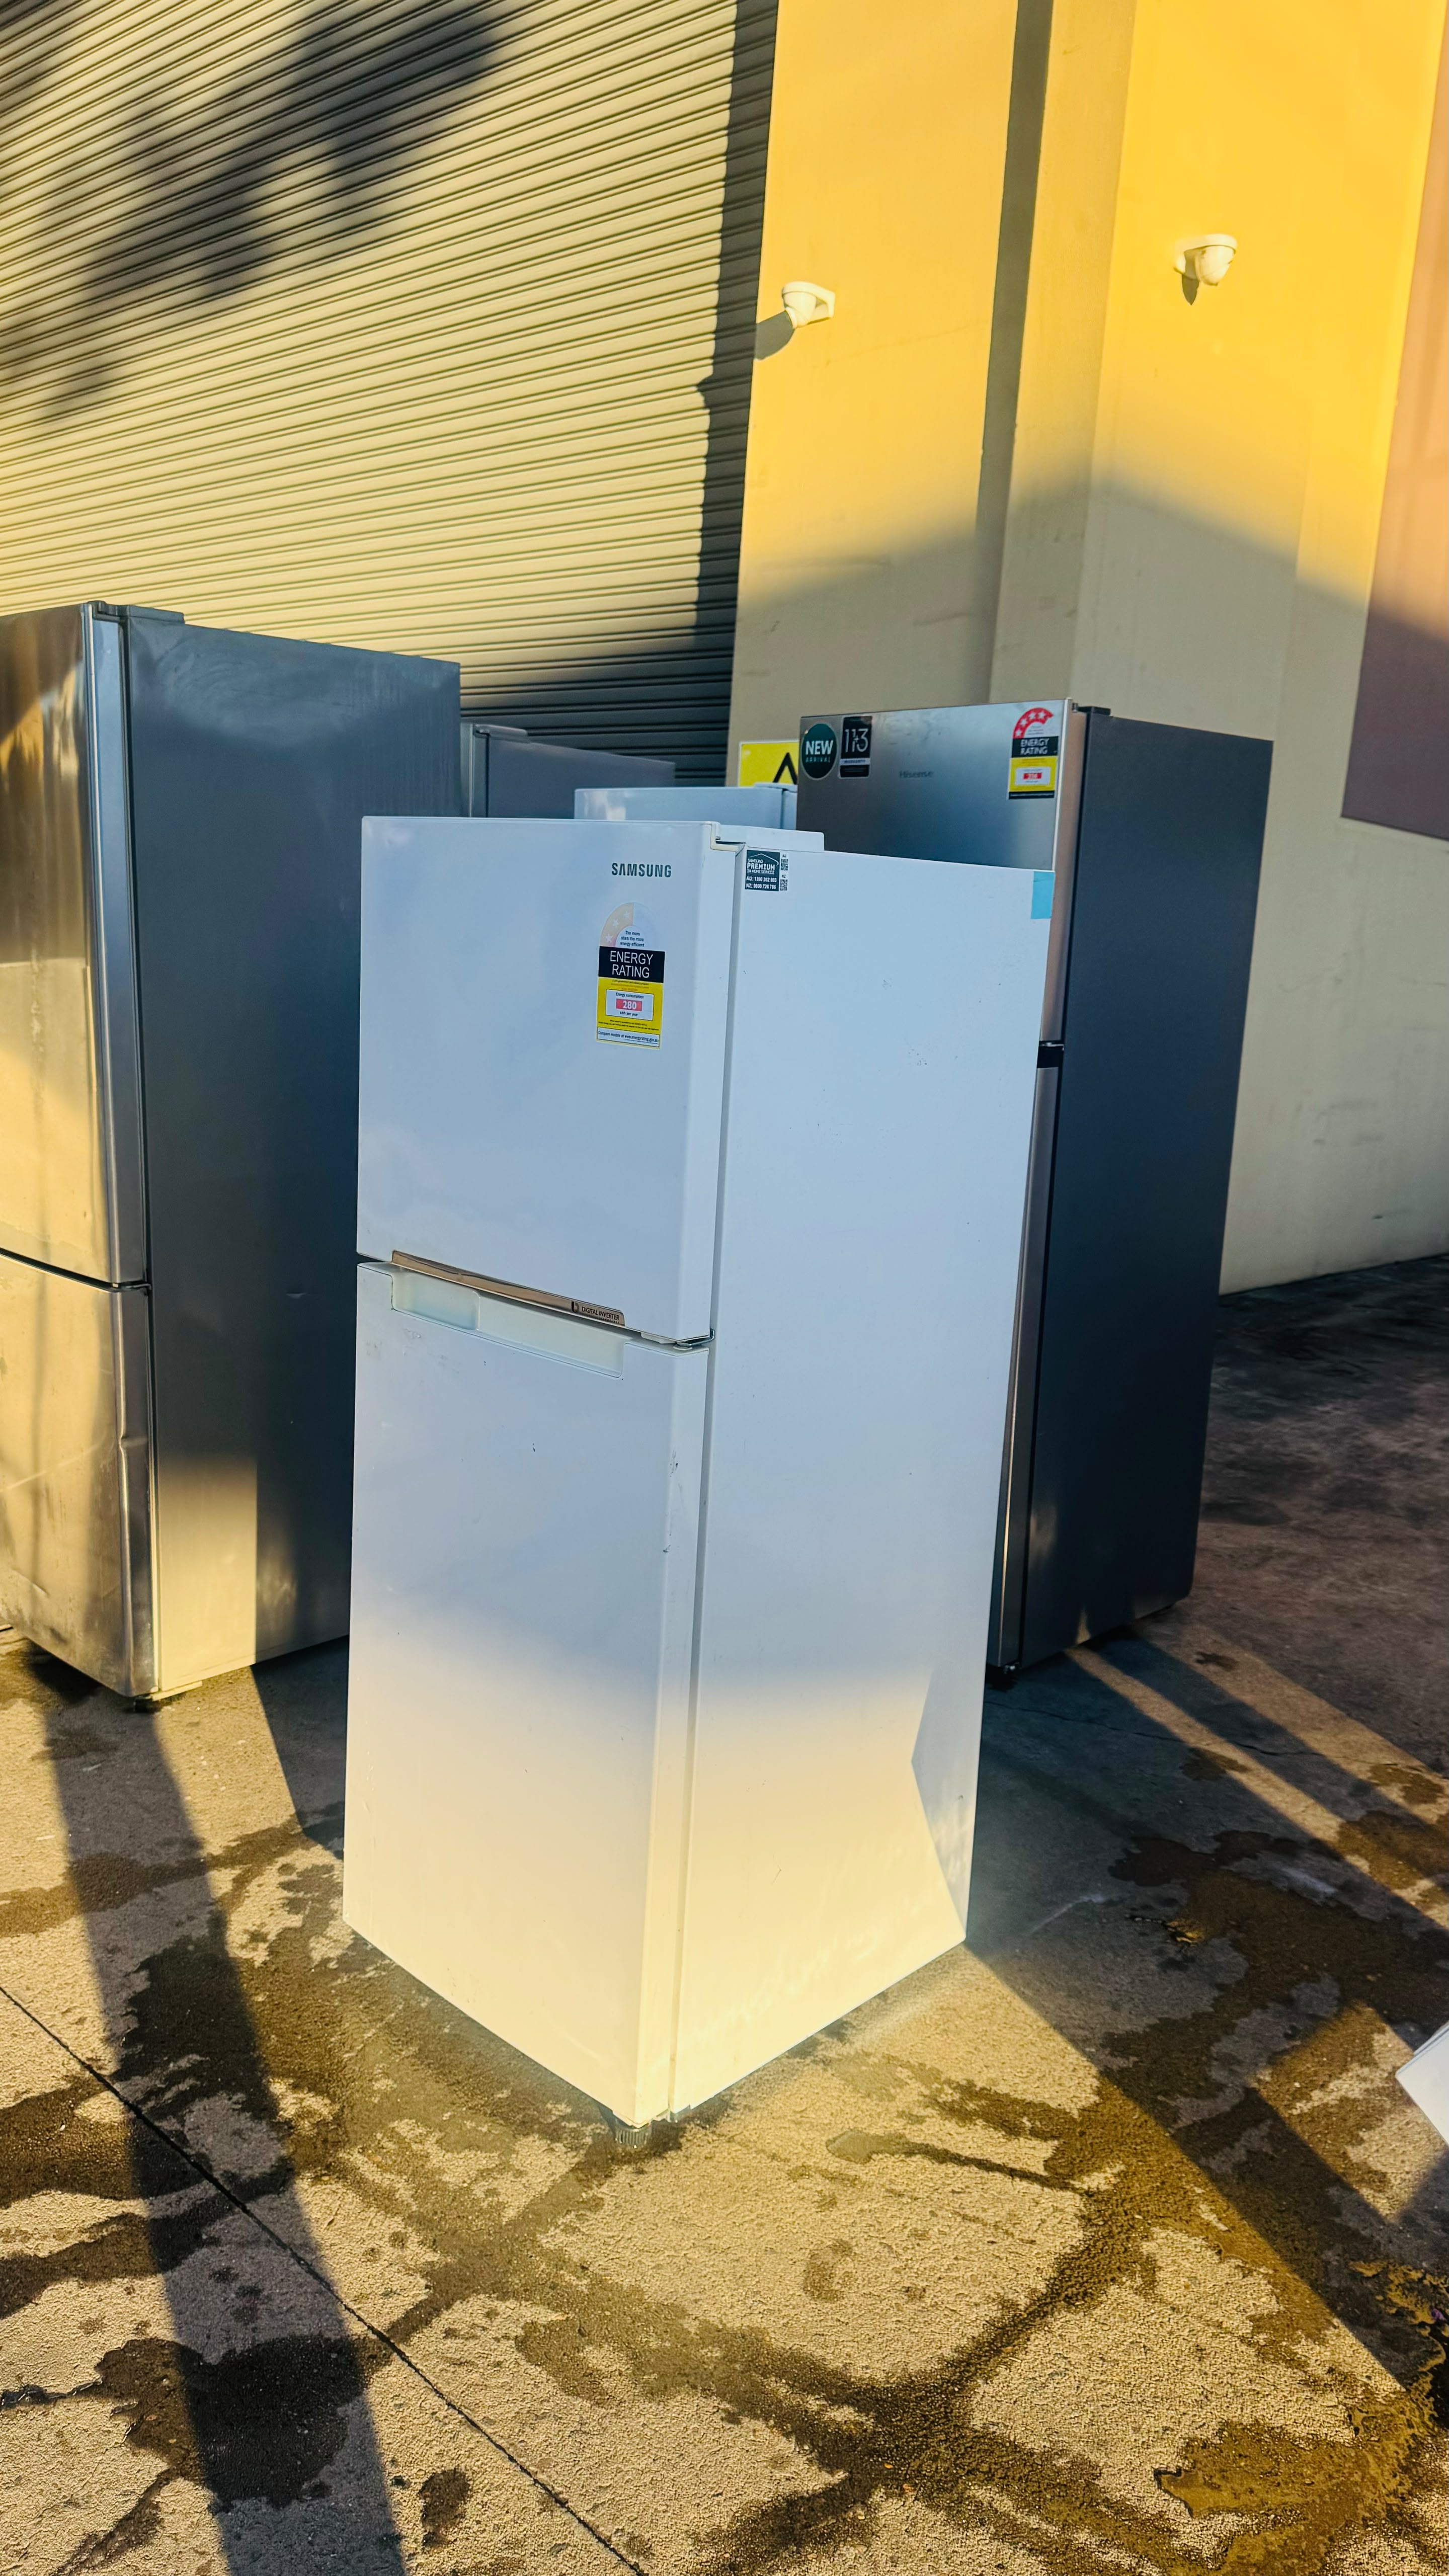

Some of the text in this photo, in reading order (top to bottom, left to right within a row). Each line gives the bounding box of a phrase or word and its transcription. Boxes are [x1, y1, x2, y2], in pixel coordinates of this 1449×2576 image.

[806, 740, 833, 755] NEW
[1020, 738, 1050, 747] ENERGY
[1020, 747, 1048, 755] RATING
[899, 770, 934, 779] Hisense
[611, 862, 672, 877] SAMSUNG
[610, 950, 654, 965] ENERGY
[612, 964, 650, 978] RATING
[622, 1000, 637, 1010] 280
[582, 1306, 598, 1316] DIGITAL
[599, 1310, 620, 1320] INVERTER
